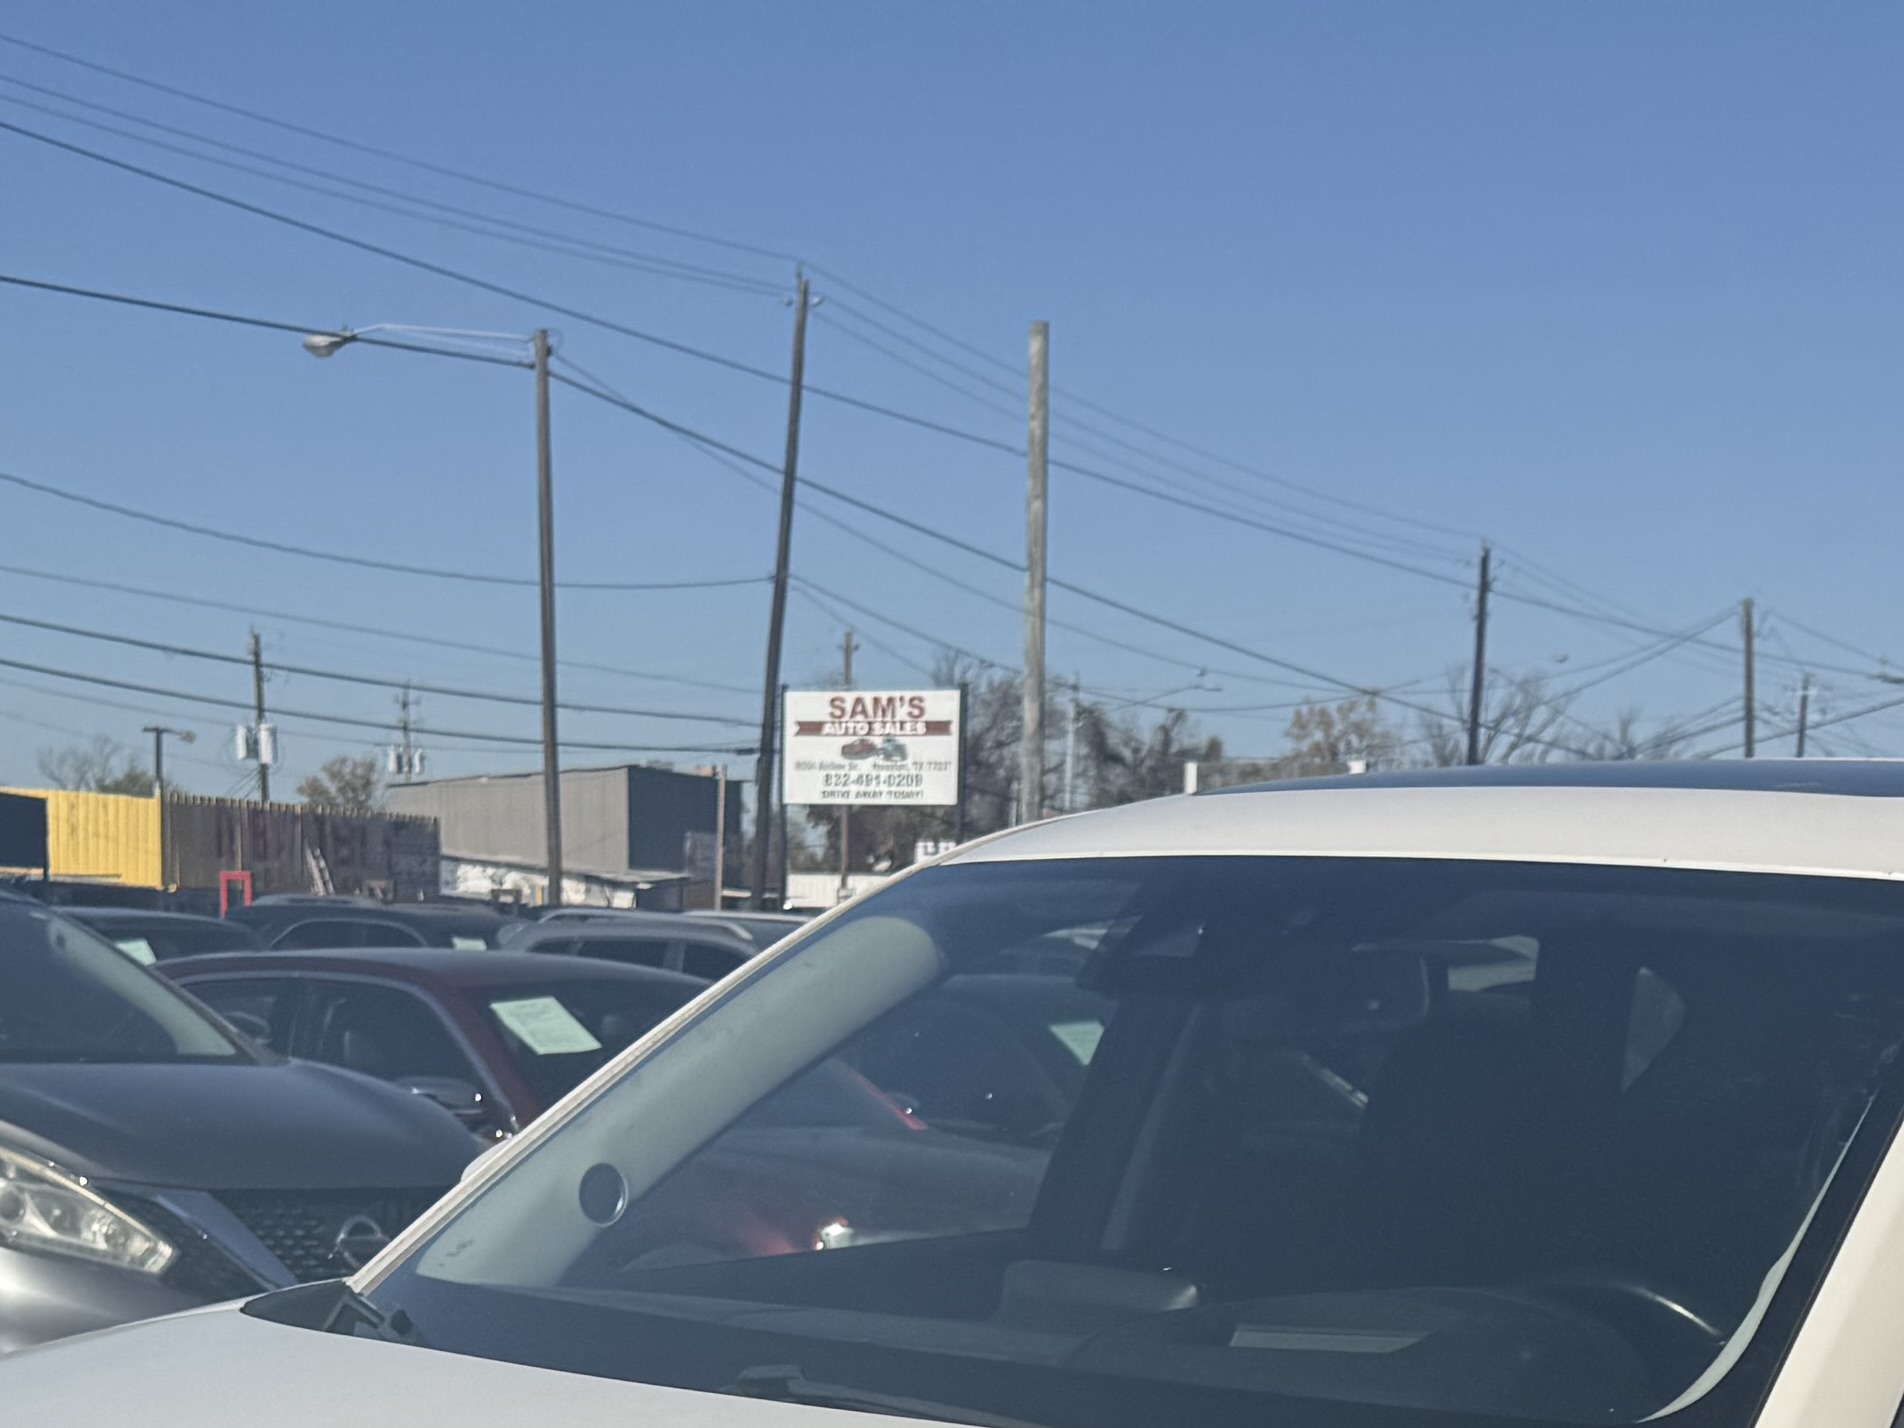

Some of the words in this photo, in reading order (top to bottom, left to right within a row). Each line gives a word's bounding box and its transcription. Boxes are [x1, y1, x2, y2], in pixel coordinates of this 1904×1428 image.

[829, 695, 926, 719] SAM'S
[820, 722, 870, 736] AUTO
[871, 722, 927, 736] SALES
